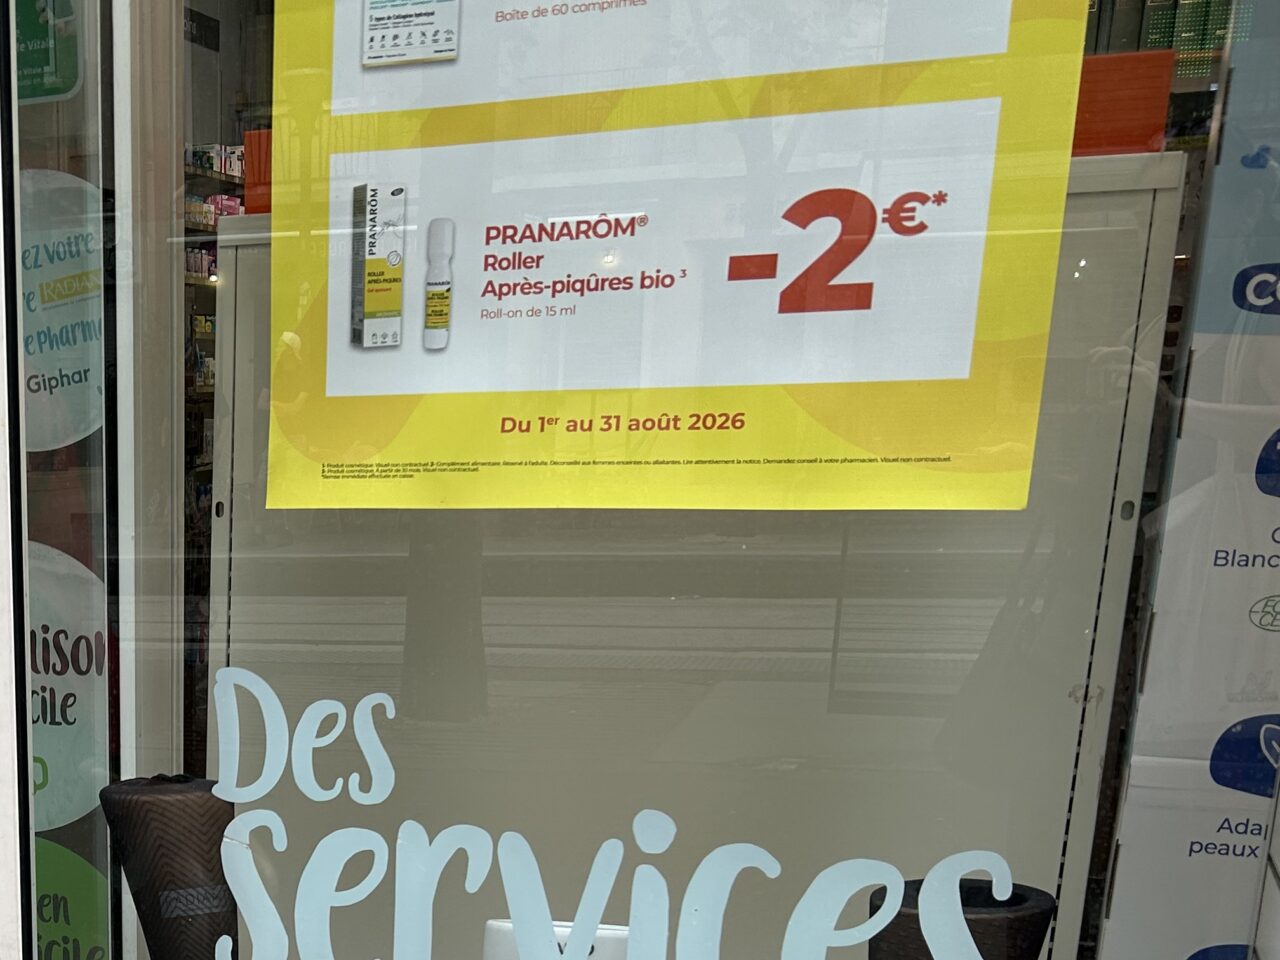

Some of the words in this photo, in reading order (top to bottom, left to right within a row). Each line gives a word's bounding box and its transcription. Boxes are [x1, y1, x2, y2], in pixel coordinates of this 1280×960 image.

[495, 9, 528, 23] Boîte
[532, 7, 549, 18] de
[551, 4, 569, 15] 60
[367, 188, 379, 256] PRANARÔM
[43, 231, 95, 265] votre
[483, 252, 544, 271] Roller
[481, 273, 634, 300] Après-piqûres
[640, 269, 675, 289] bio
[1246, 272, 1280, 306] C
[480, 308, 523, 320] Roll-on
[526, 307, 542, 318] de
[545, 306, 557, 317] 15
[560, 305, 576, 316] ml
[27, 367, 91, 395] Giphar
[500, 417, 531, 433] Du
[538, 415, 560, 432] 1er
[566, 418, 593, 432] au
[599, 415, 621, 432] 31
[628, 413, 681, 431] août
[688, 412, 746, 431] 2026
[211, 665, 397, 805] Des
[1188, 840, 1260, 858] peaux
